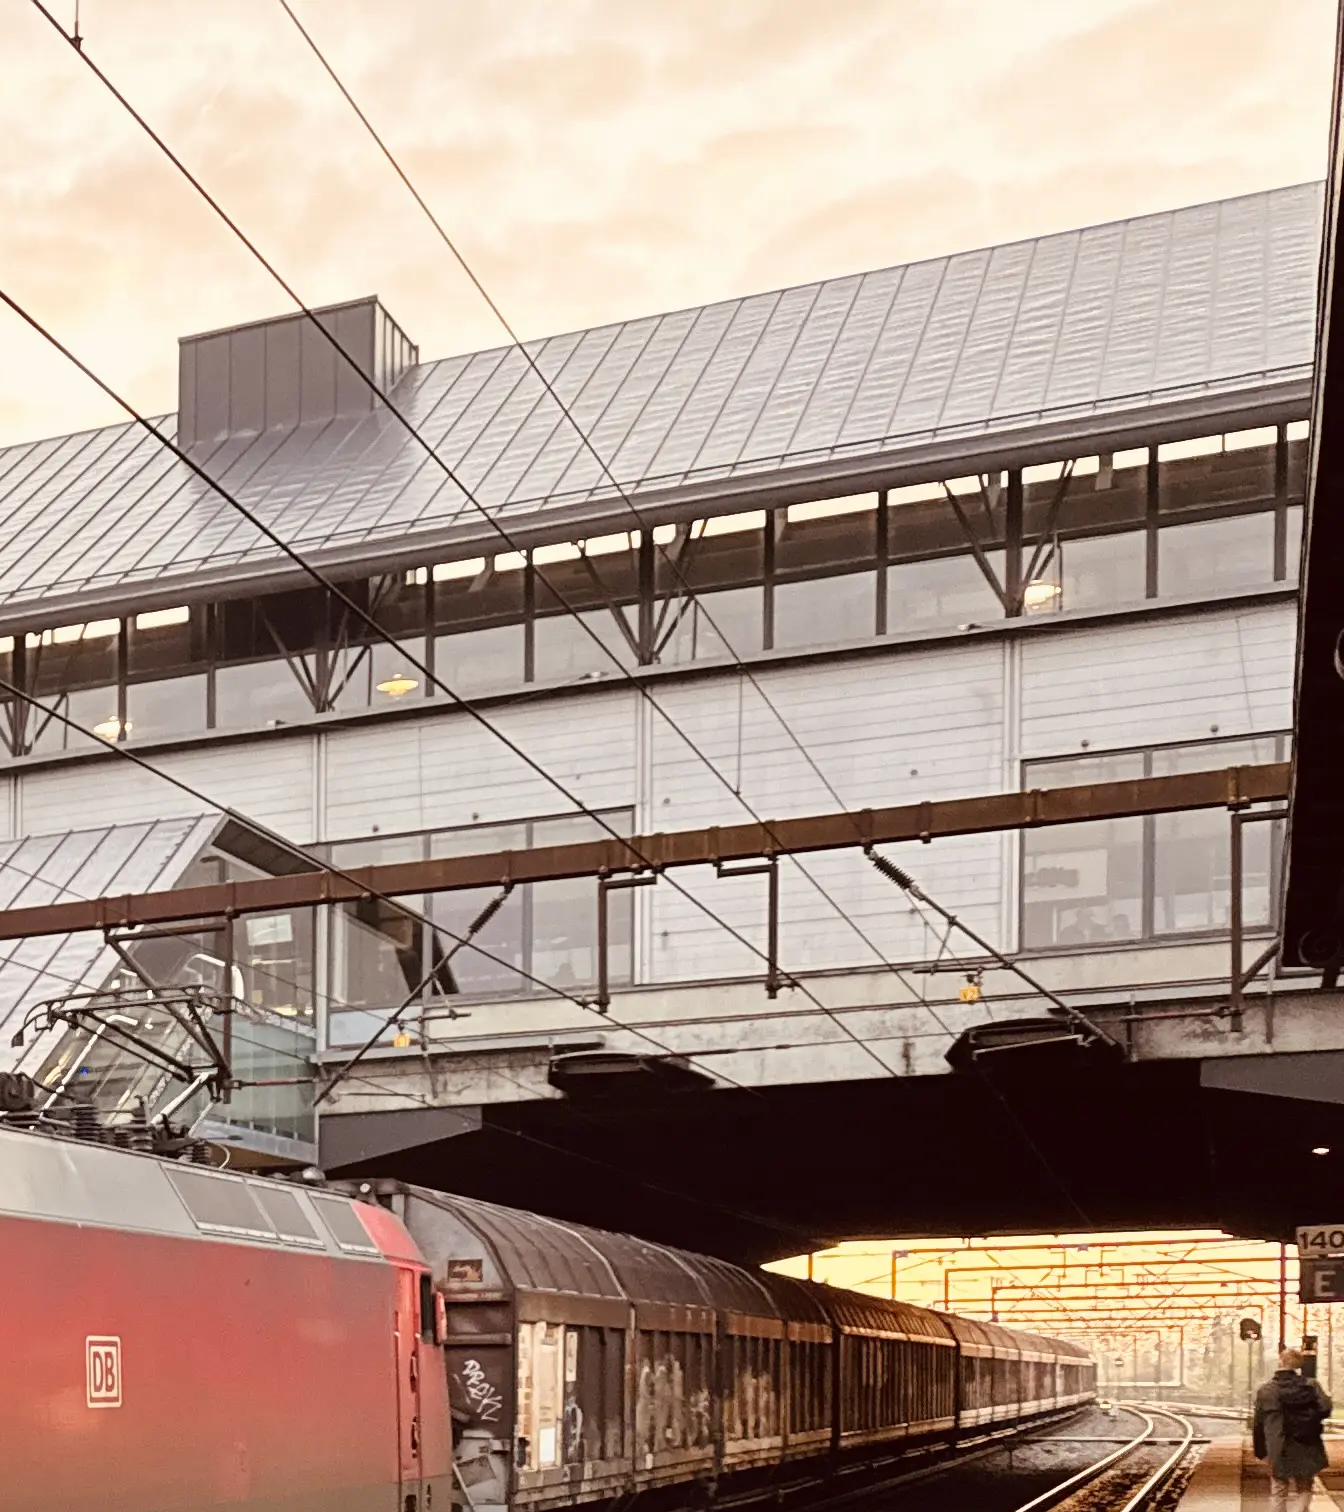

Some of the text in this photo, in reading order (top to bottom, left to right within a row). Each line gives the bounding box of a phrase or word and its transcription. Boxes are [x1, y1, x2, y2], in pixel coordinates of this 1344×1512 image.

[1299, 1230, 1344, 1250] 140
[1314, 1270, 1336, 1297] E
[92, 1350, 115, 1392] DB
